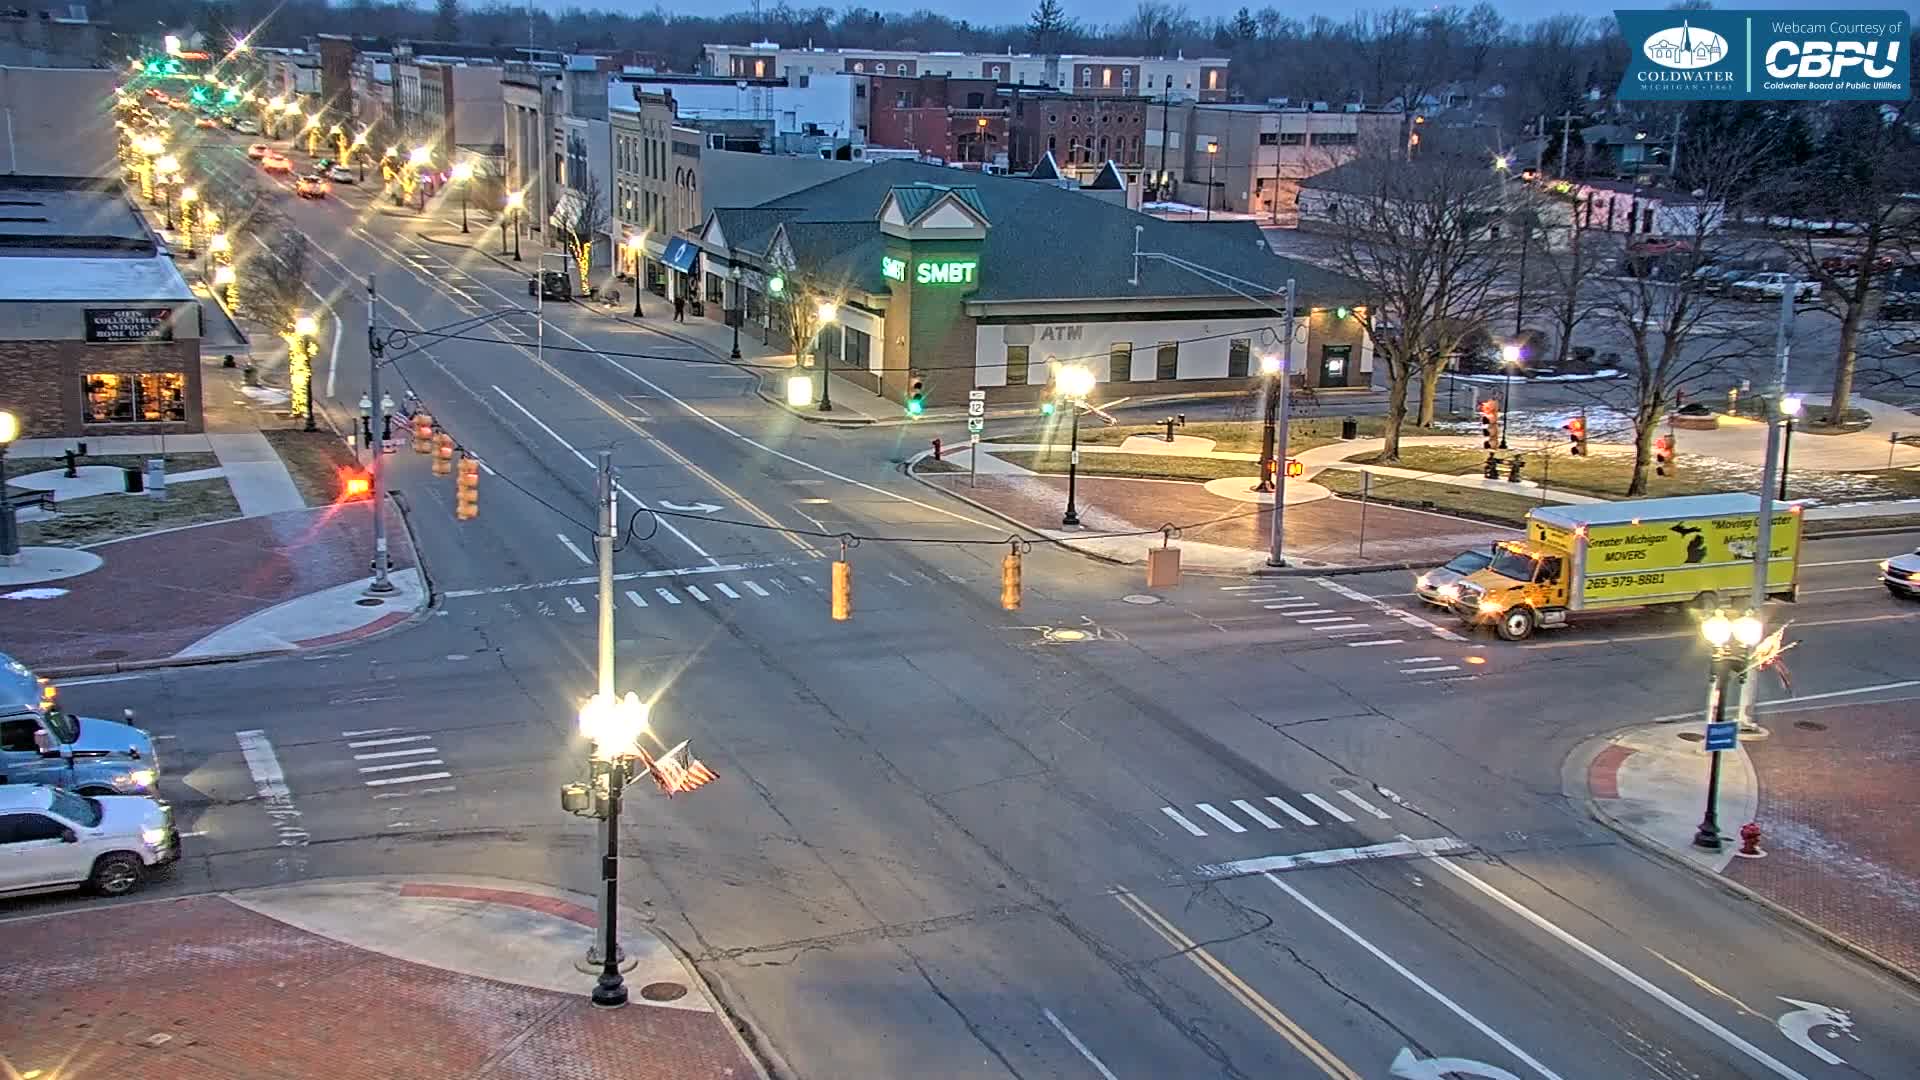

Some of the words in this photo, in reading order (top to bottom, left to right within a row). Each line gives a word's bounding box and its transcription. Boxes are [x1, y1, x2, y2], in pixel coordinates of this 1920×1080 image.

[917, 262, 976, 284] SMBT
[1040, 325, 1083, 341] ATM
[971, 403, 982, 413] 12
[1624, 534, 1668, 547] Michigan
[1604, 549, 1647, 562] MOVERS
